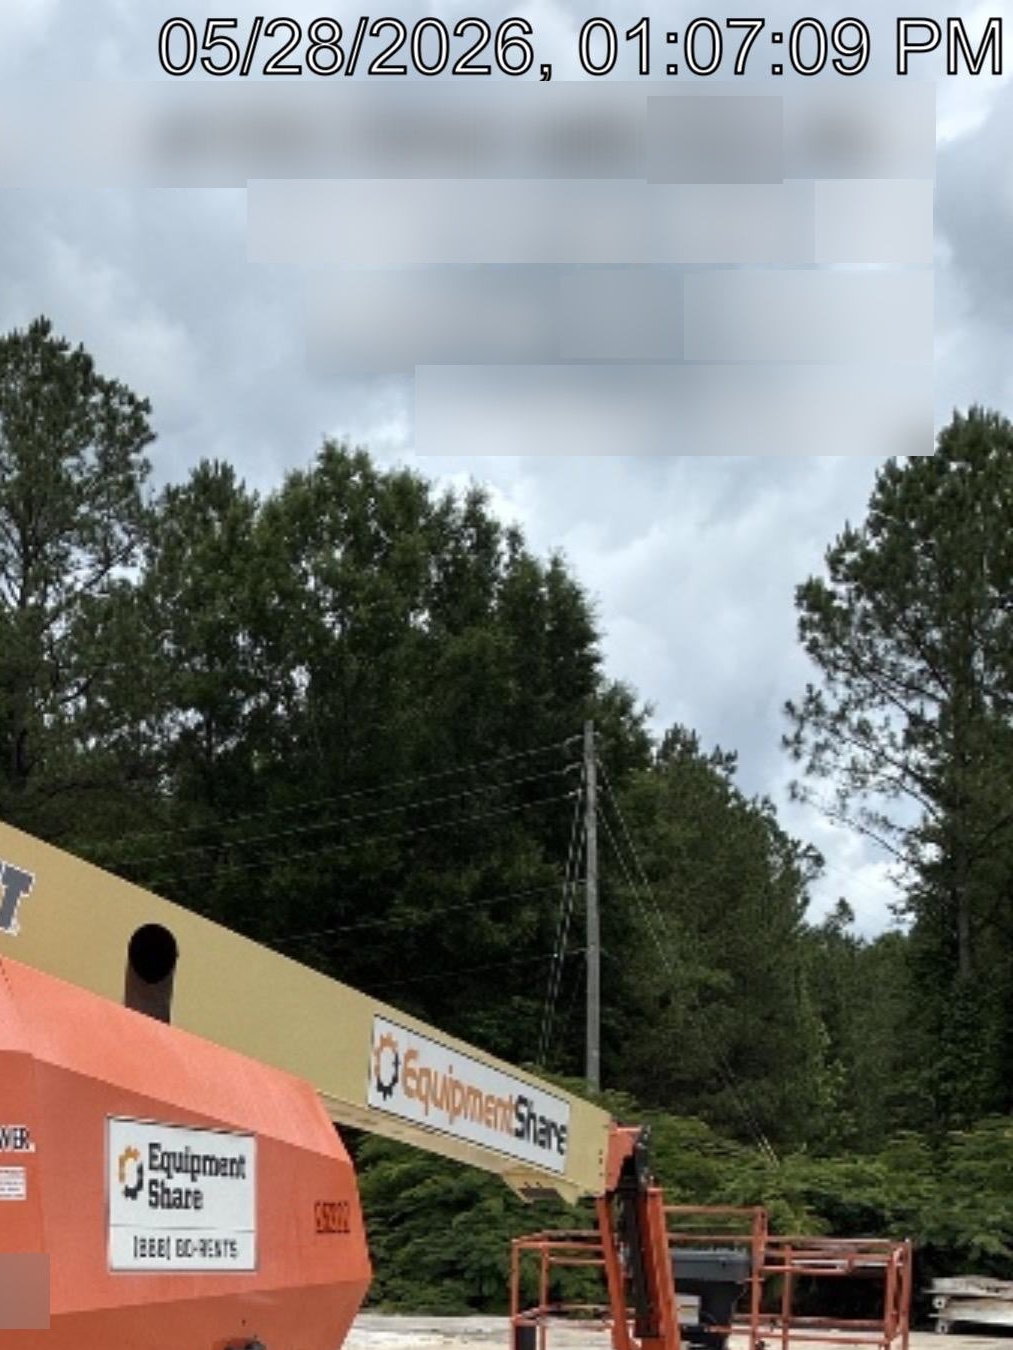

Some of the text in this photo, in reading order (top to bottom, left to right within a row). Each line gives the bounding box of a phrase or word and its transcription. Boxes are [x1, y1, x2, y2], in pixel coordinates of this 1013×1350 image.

[402, 1049, 567, 1155] EquipmentShare
[148, 1143, 246, 1182] Equipment
[148, 1179, 204, 1209] Share
